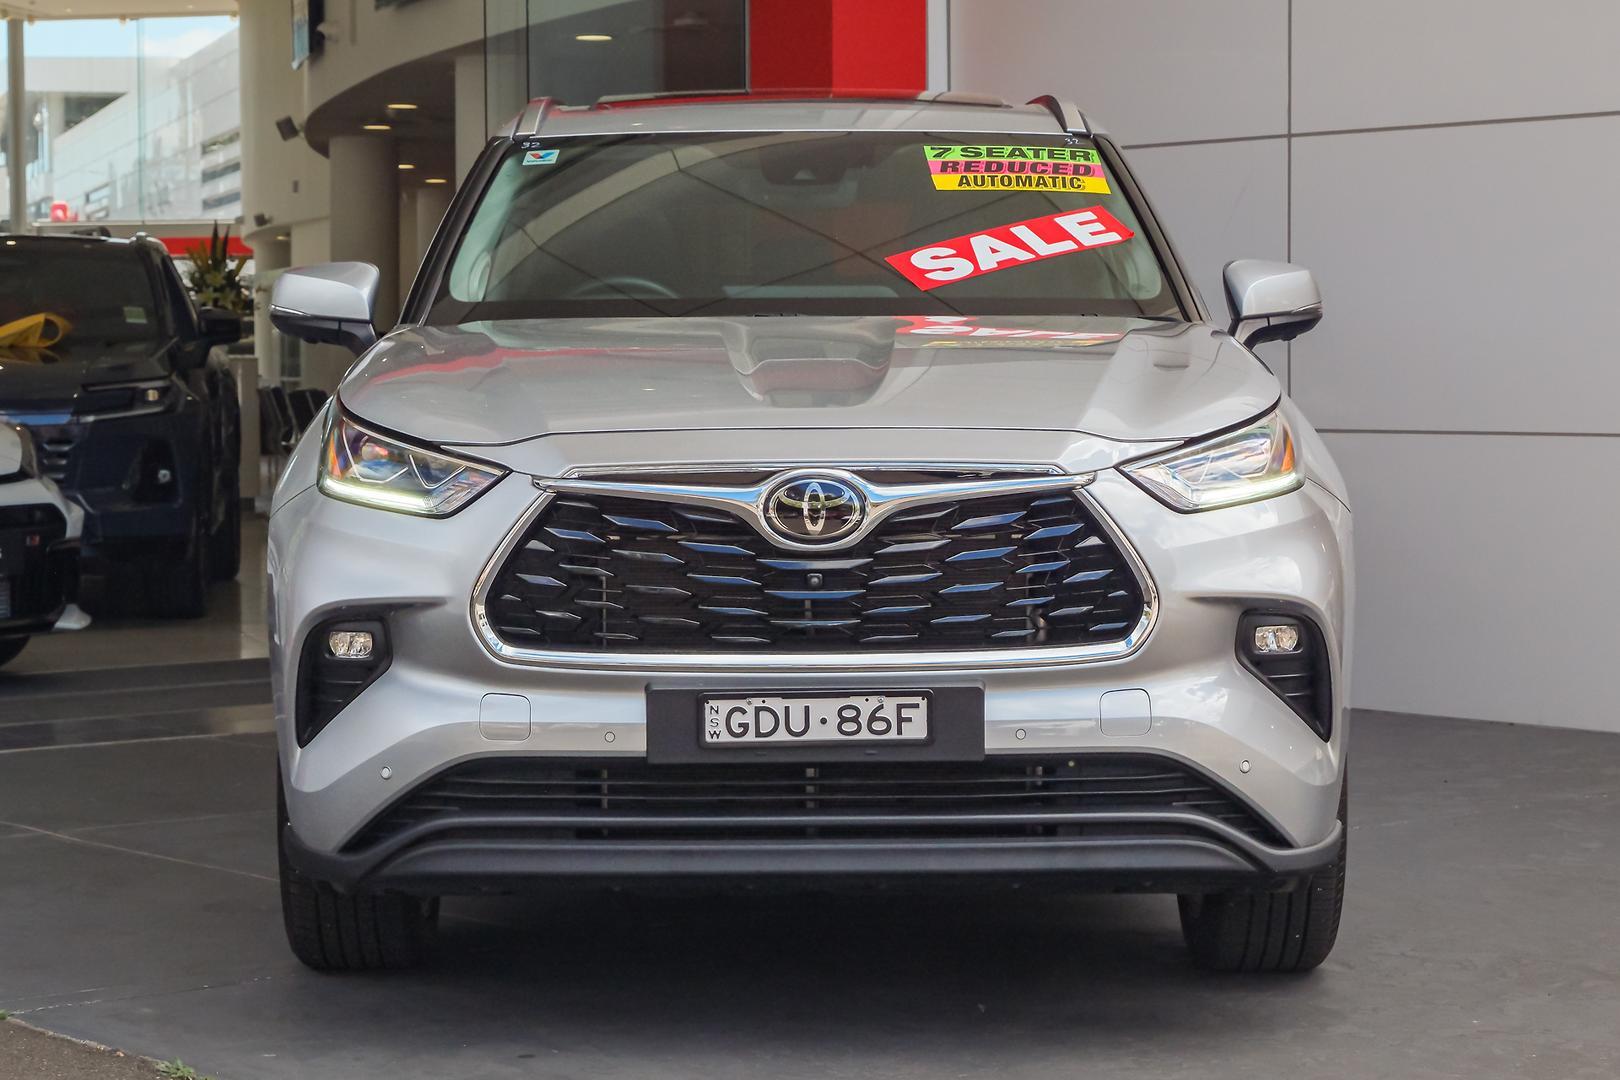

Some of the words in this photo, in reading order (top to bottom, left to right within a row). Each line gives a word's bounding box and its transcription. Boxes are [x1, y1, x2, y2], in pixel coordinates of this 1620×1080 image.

[930, 147, 952, 158] 7
[960, 147, 1093, 162] SEATER
[940, 161, 1093, 177] REDUCED
[958, 175, 1083, 190] AUTOMATIC
[910, 211, 1122, 281] SALE
[708, 705, 722, 740] NSW
